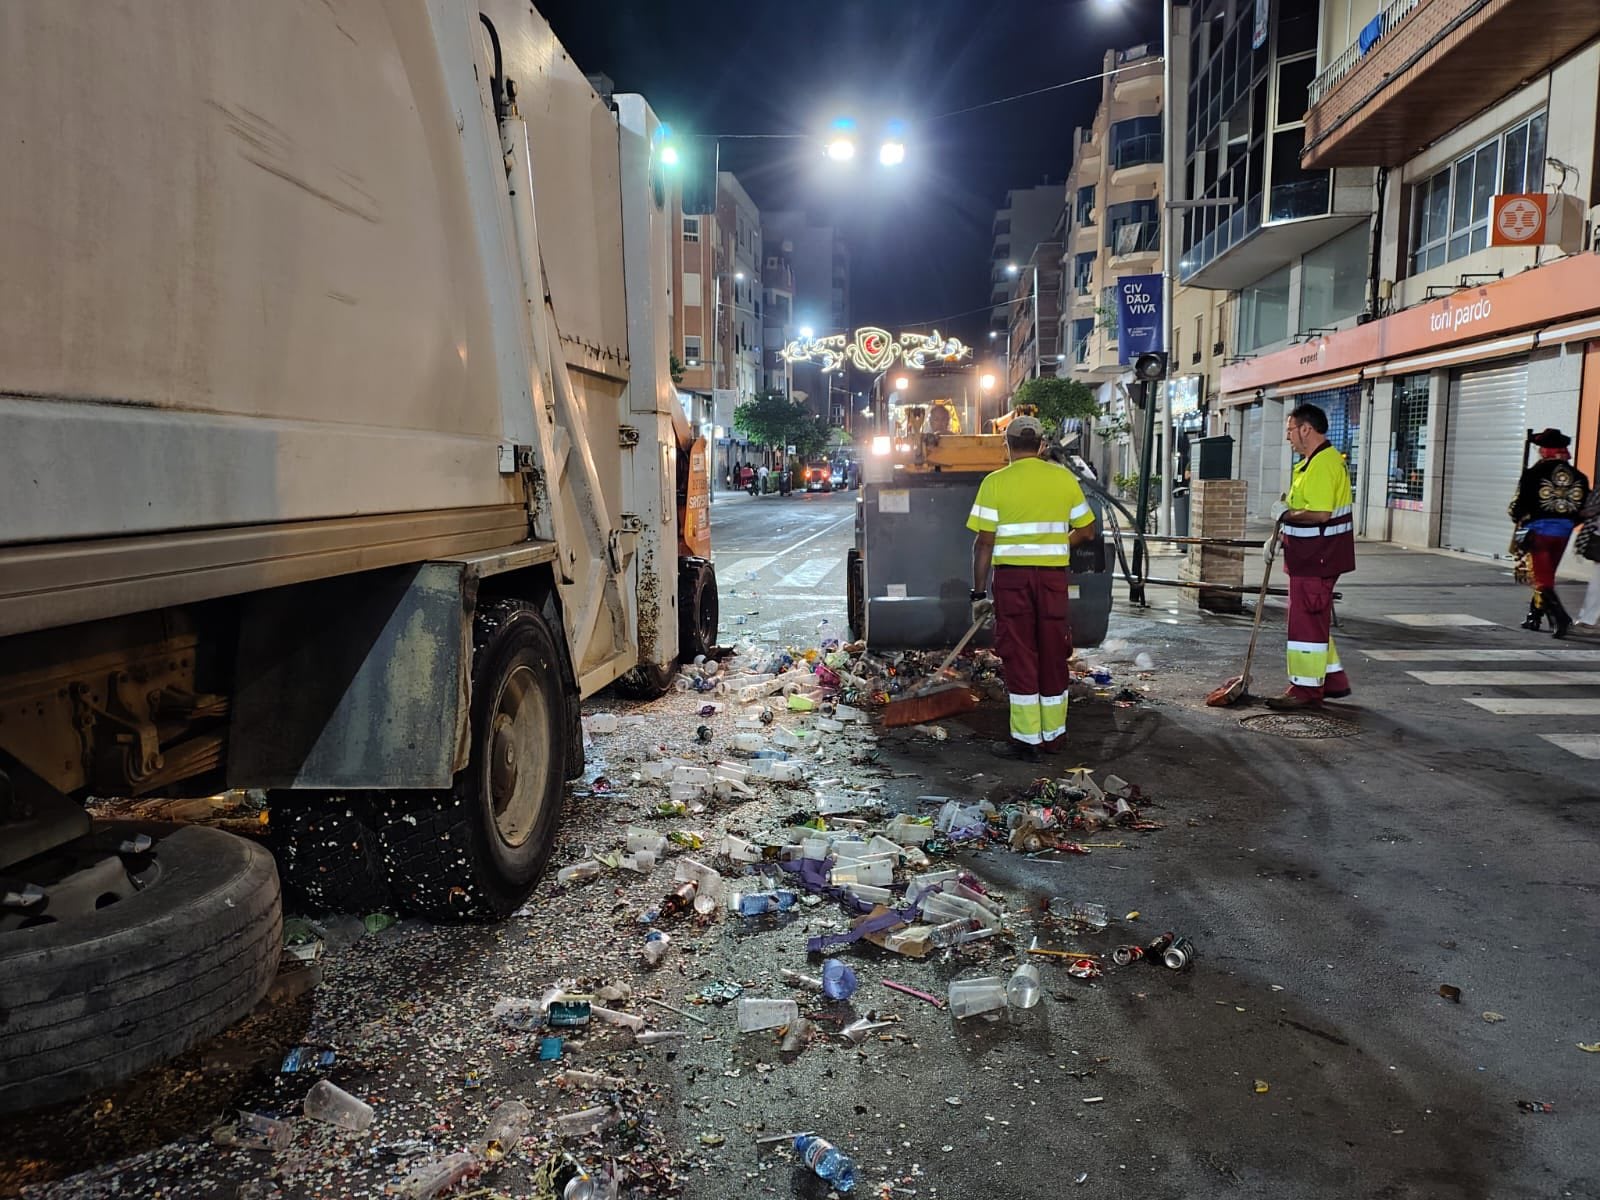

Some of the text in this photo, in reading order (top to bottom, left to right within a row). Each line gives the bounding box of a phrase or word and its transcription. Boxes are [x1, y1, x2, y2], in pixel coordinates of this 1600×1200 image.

[1123, 284, 1142, 294] CIV
[1129, 304, 1156, 314] VIVA
[1430, 298, 1491, 332] toni pardo
[1300, 352, 1318, 366] expert
